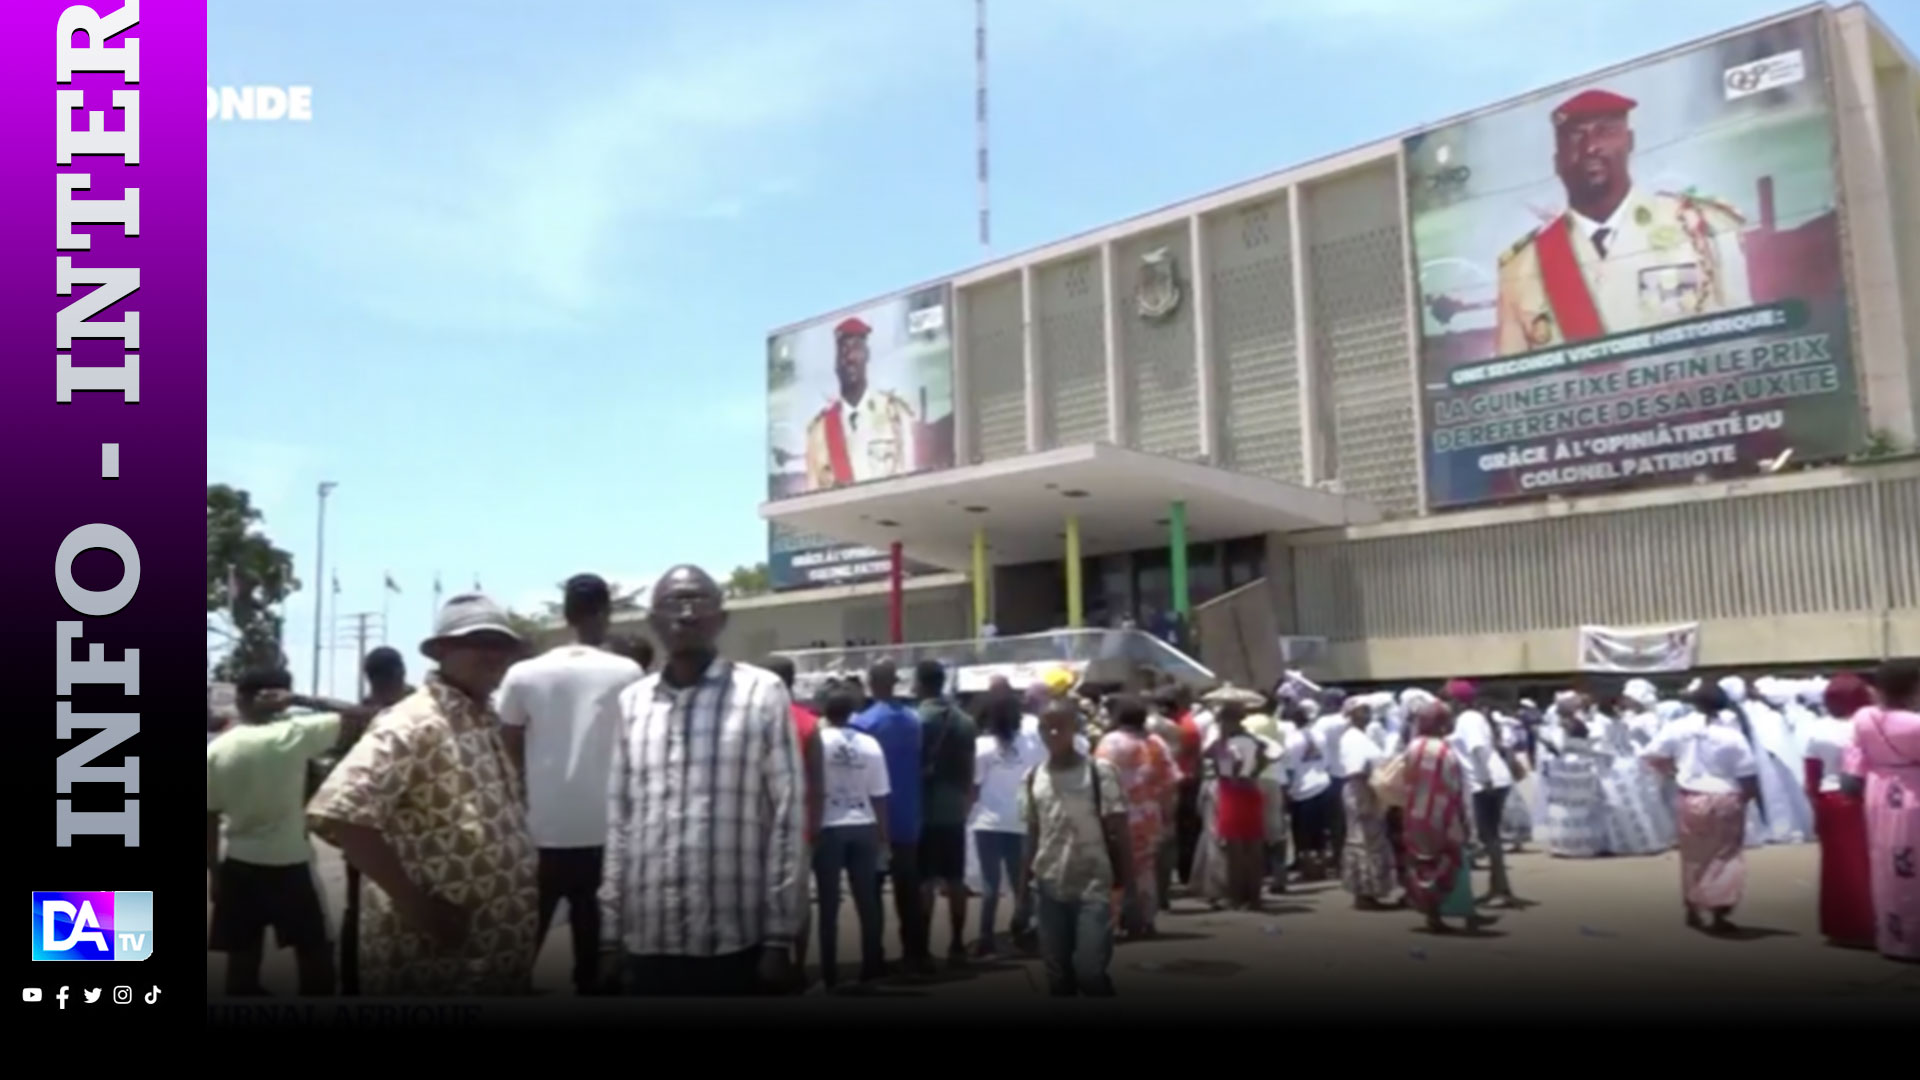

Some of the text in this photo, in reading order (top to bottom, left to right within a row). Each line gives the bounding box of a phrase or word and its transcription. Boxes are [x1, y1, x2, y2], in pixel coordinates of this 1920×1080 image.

[1434, 427, 1468, 452] DE
[1615, 397, 1650, 423] DE
[1654, 390, 1694, 416] SA
[1698, 366, 1838, 408] BAUXITE
[1436, 335, 1829, 424] LA GUINÉE FIXE ENFIN LE PRIX
[1478, 446, 1549, 472] GRÂCE
[1554, 437, 1570, 461] À
[1746, 410, 1784, 433] DU
[1520, 445, 1736, 489] COLONEL PATRIOTE
